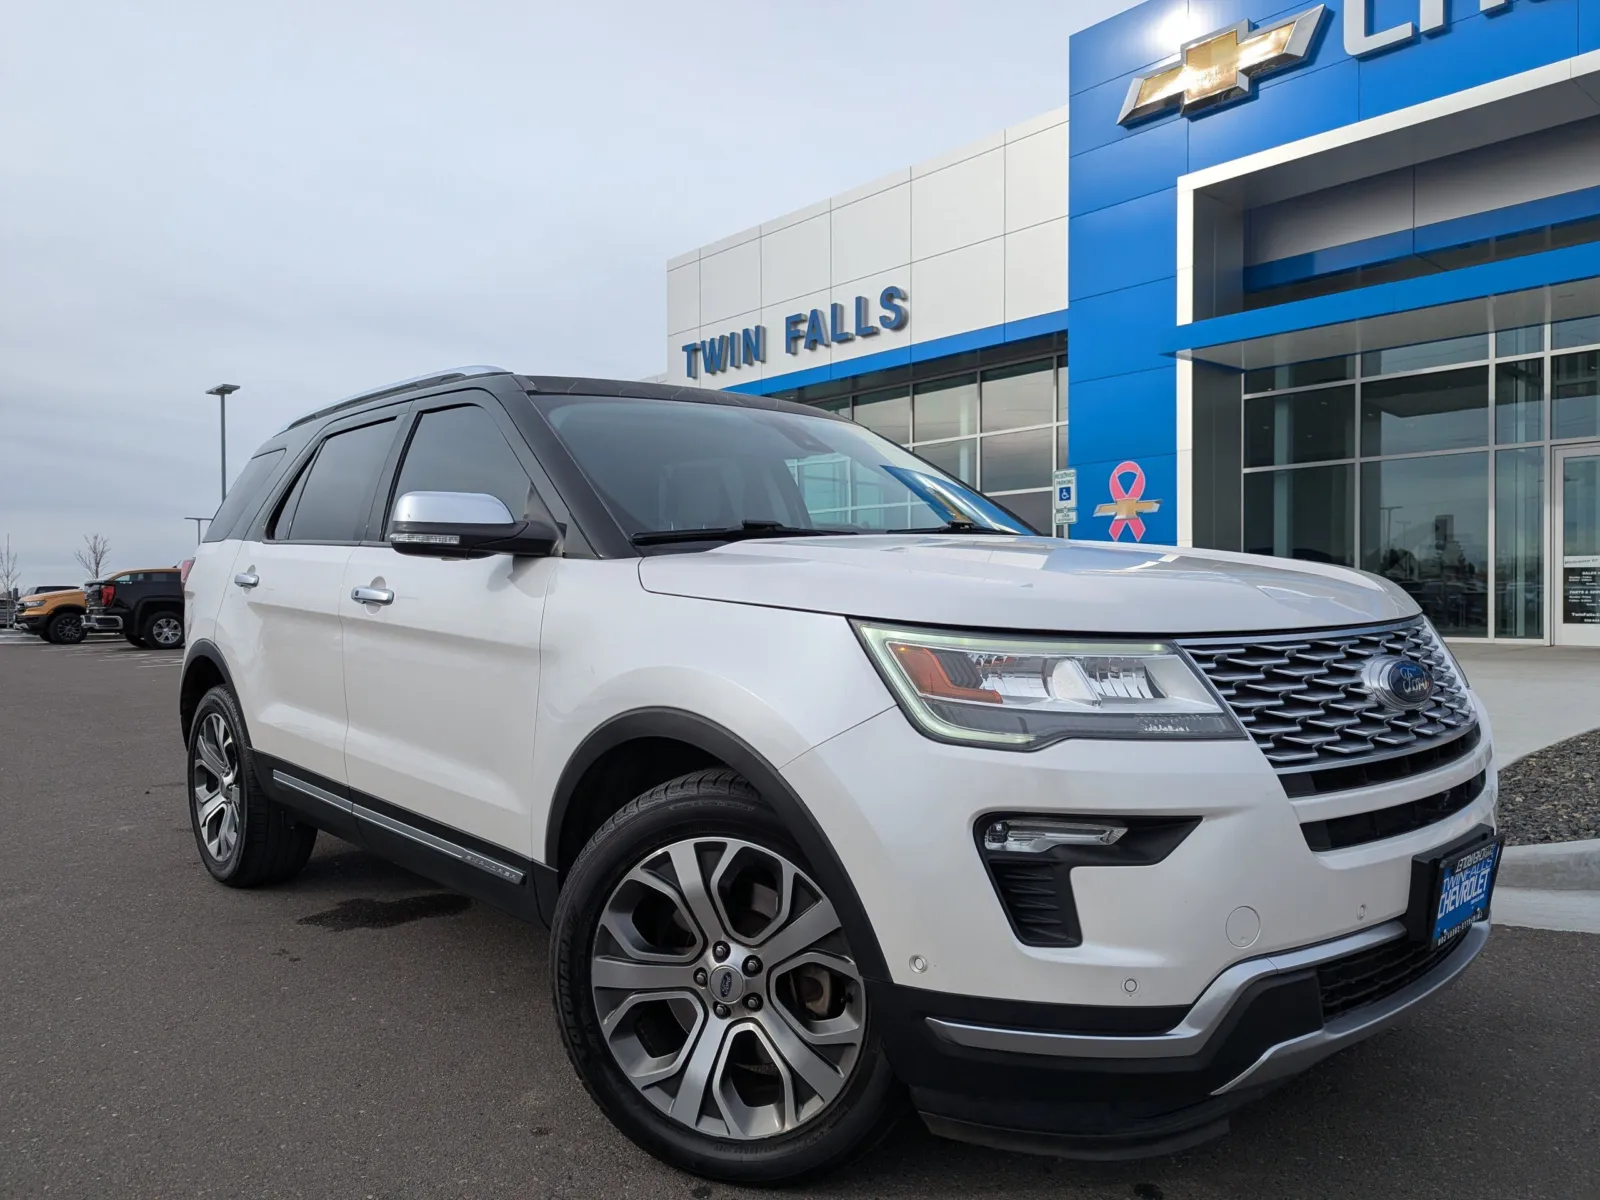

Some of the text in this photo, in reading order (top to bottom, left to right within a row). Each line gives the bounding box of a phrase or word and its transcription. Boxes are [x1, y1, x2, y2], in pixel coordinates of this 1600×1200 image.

[681, 285, 910, 379] TWIN FALLS
[1399, 667, 1430, 694] Ford
[1437, 868, 1491, 919] CHEVROLET
